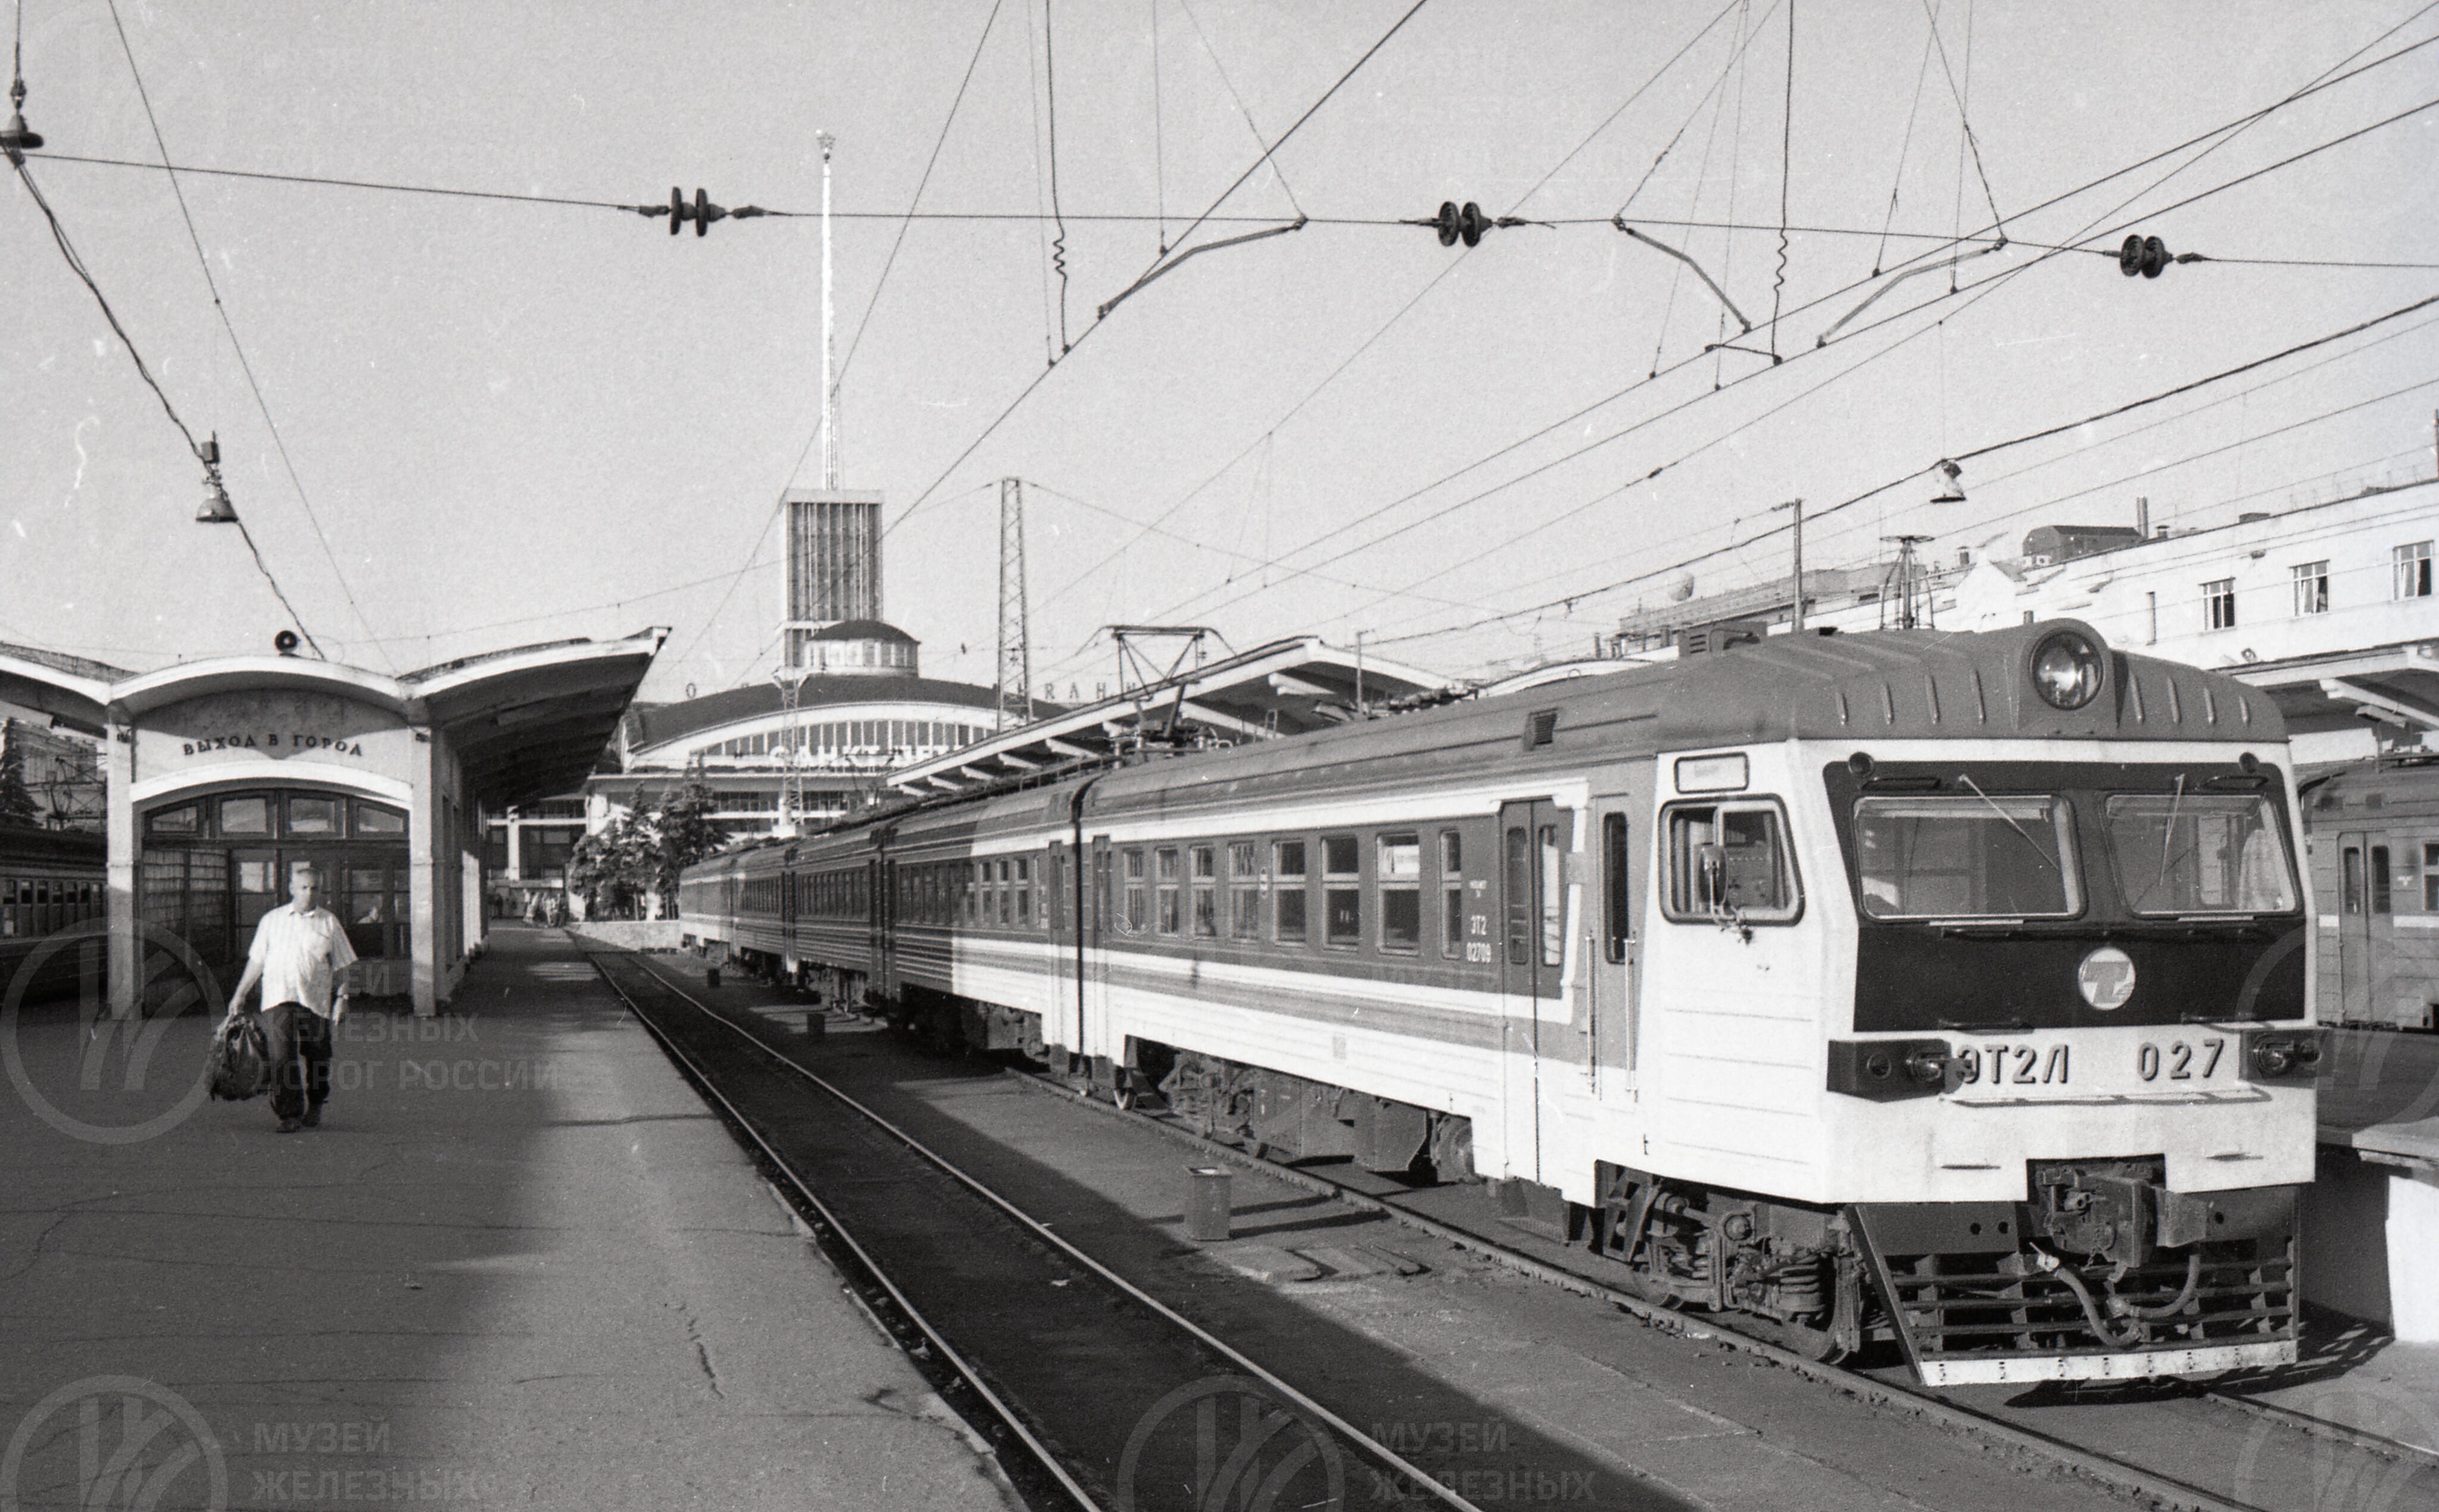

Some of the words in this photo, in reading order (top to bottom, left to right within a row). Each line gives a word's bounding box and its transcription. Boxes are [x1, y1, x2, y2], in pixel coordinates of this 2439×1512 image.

[183, 735, 257, 755] ВЫХОД
[269, 734, 279, 746] В
[293, 735, 363, 757] ГОРОД
[2137, 1038, 2224, 1081] 027
